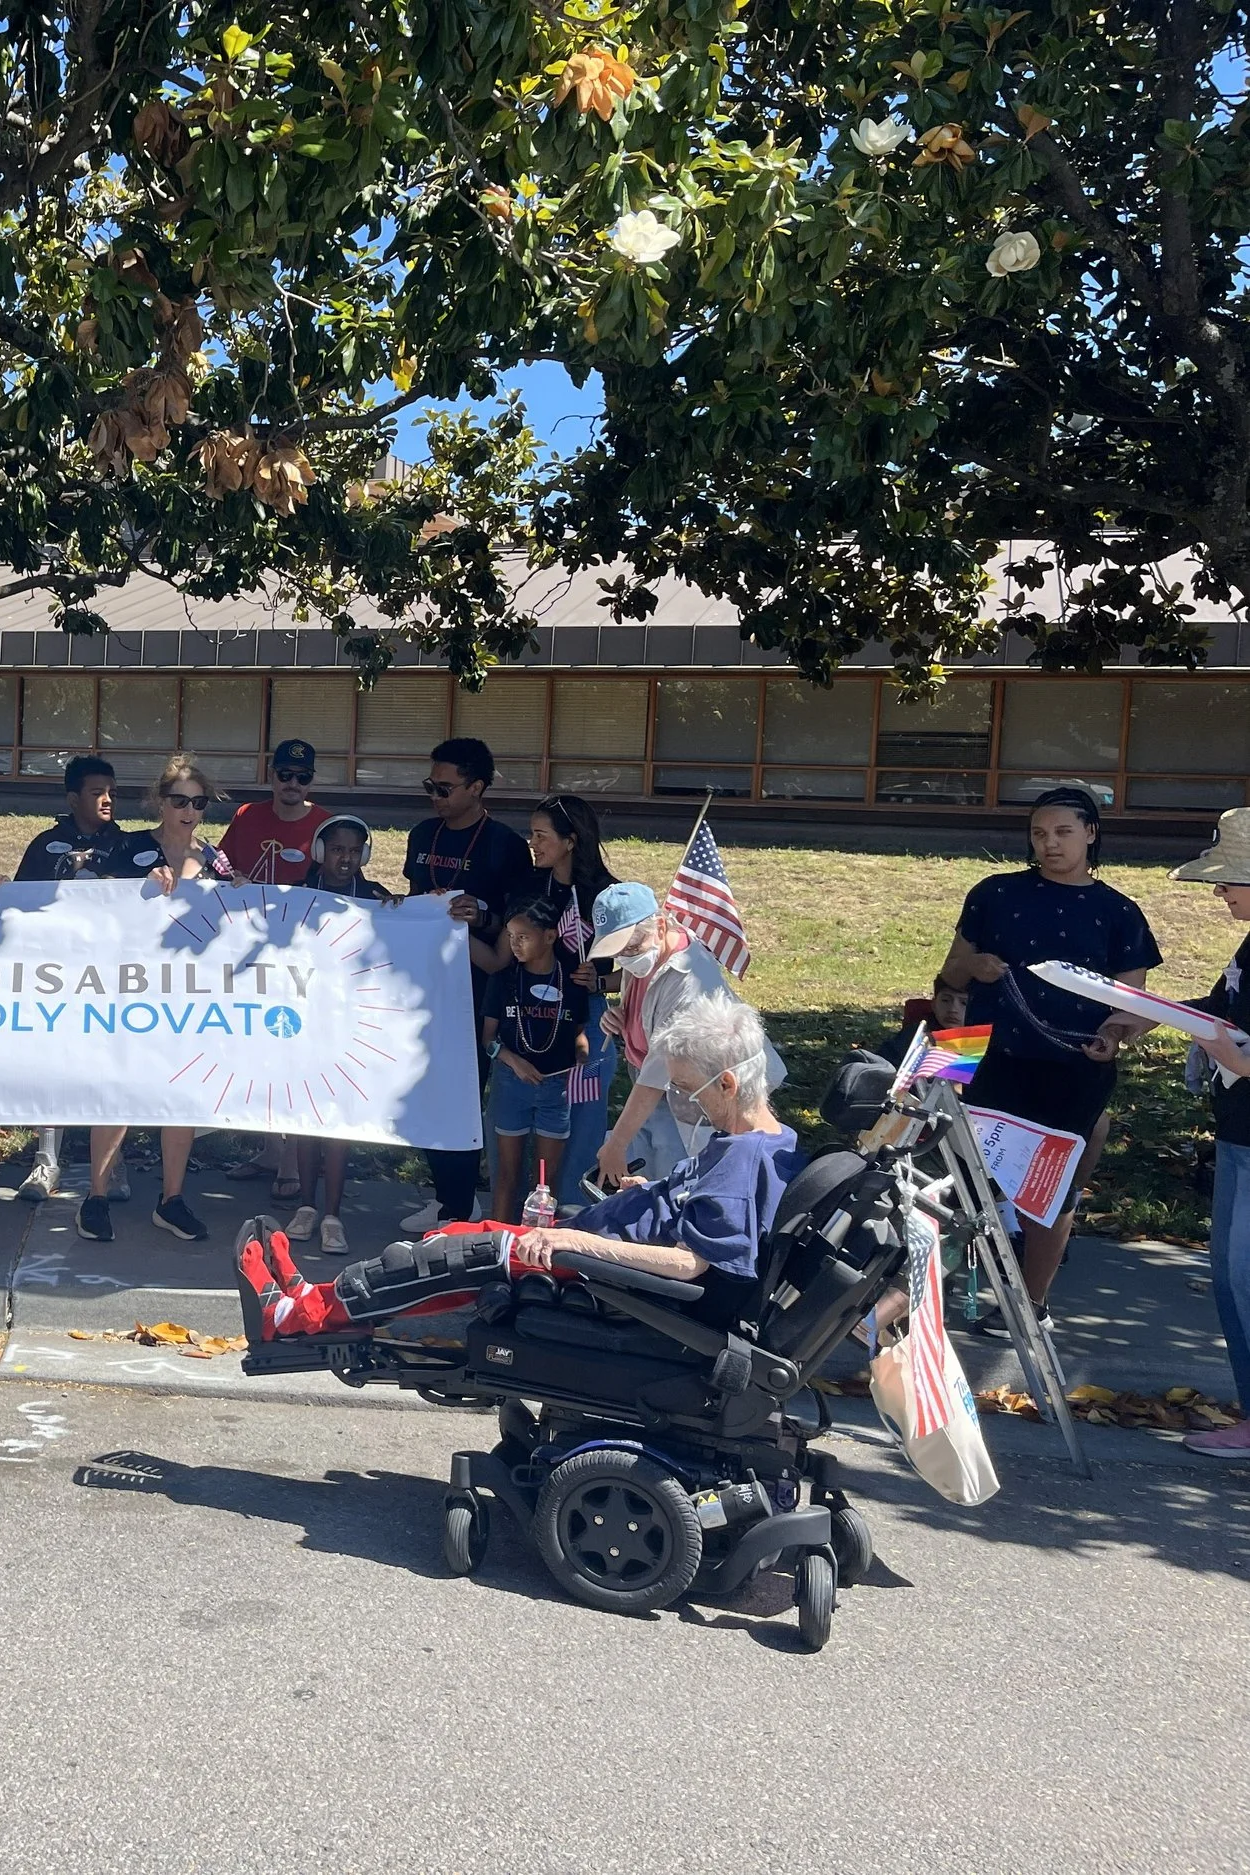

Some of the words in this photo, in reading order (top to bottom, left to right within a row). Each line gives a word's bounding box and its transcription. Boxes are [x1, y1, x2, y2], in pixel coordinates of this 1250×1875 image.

[416, 852, 427, 864] BE
[505, 1006, 516, 1018] BE
[984, 1121, 1006, 1147] 5pm
[991, 1148, 1006, 1171] FROM
[495, 1347, 511, 1356] JAY
